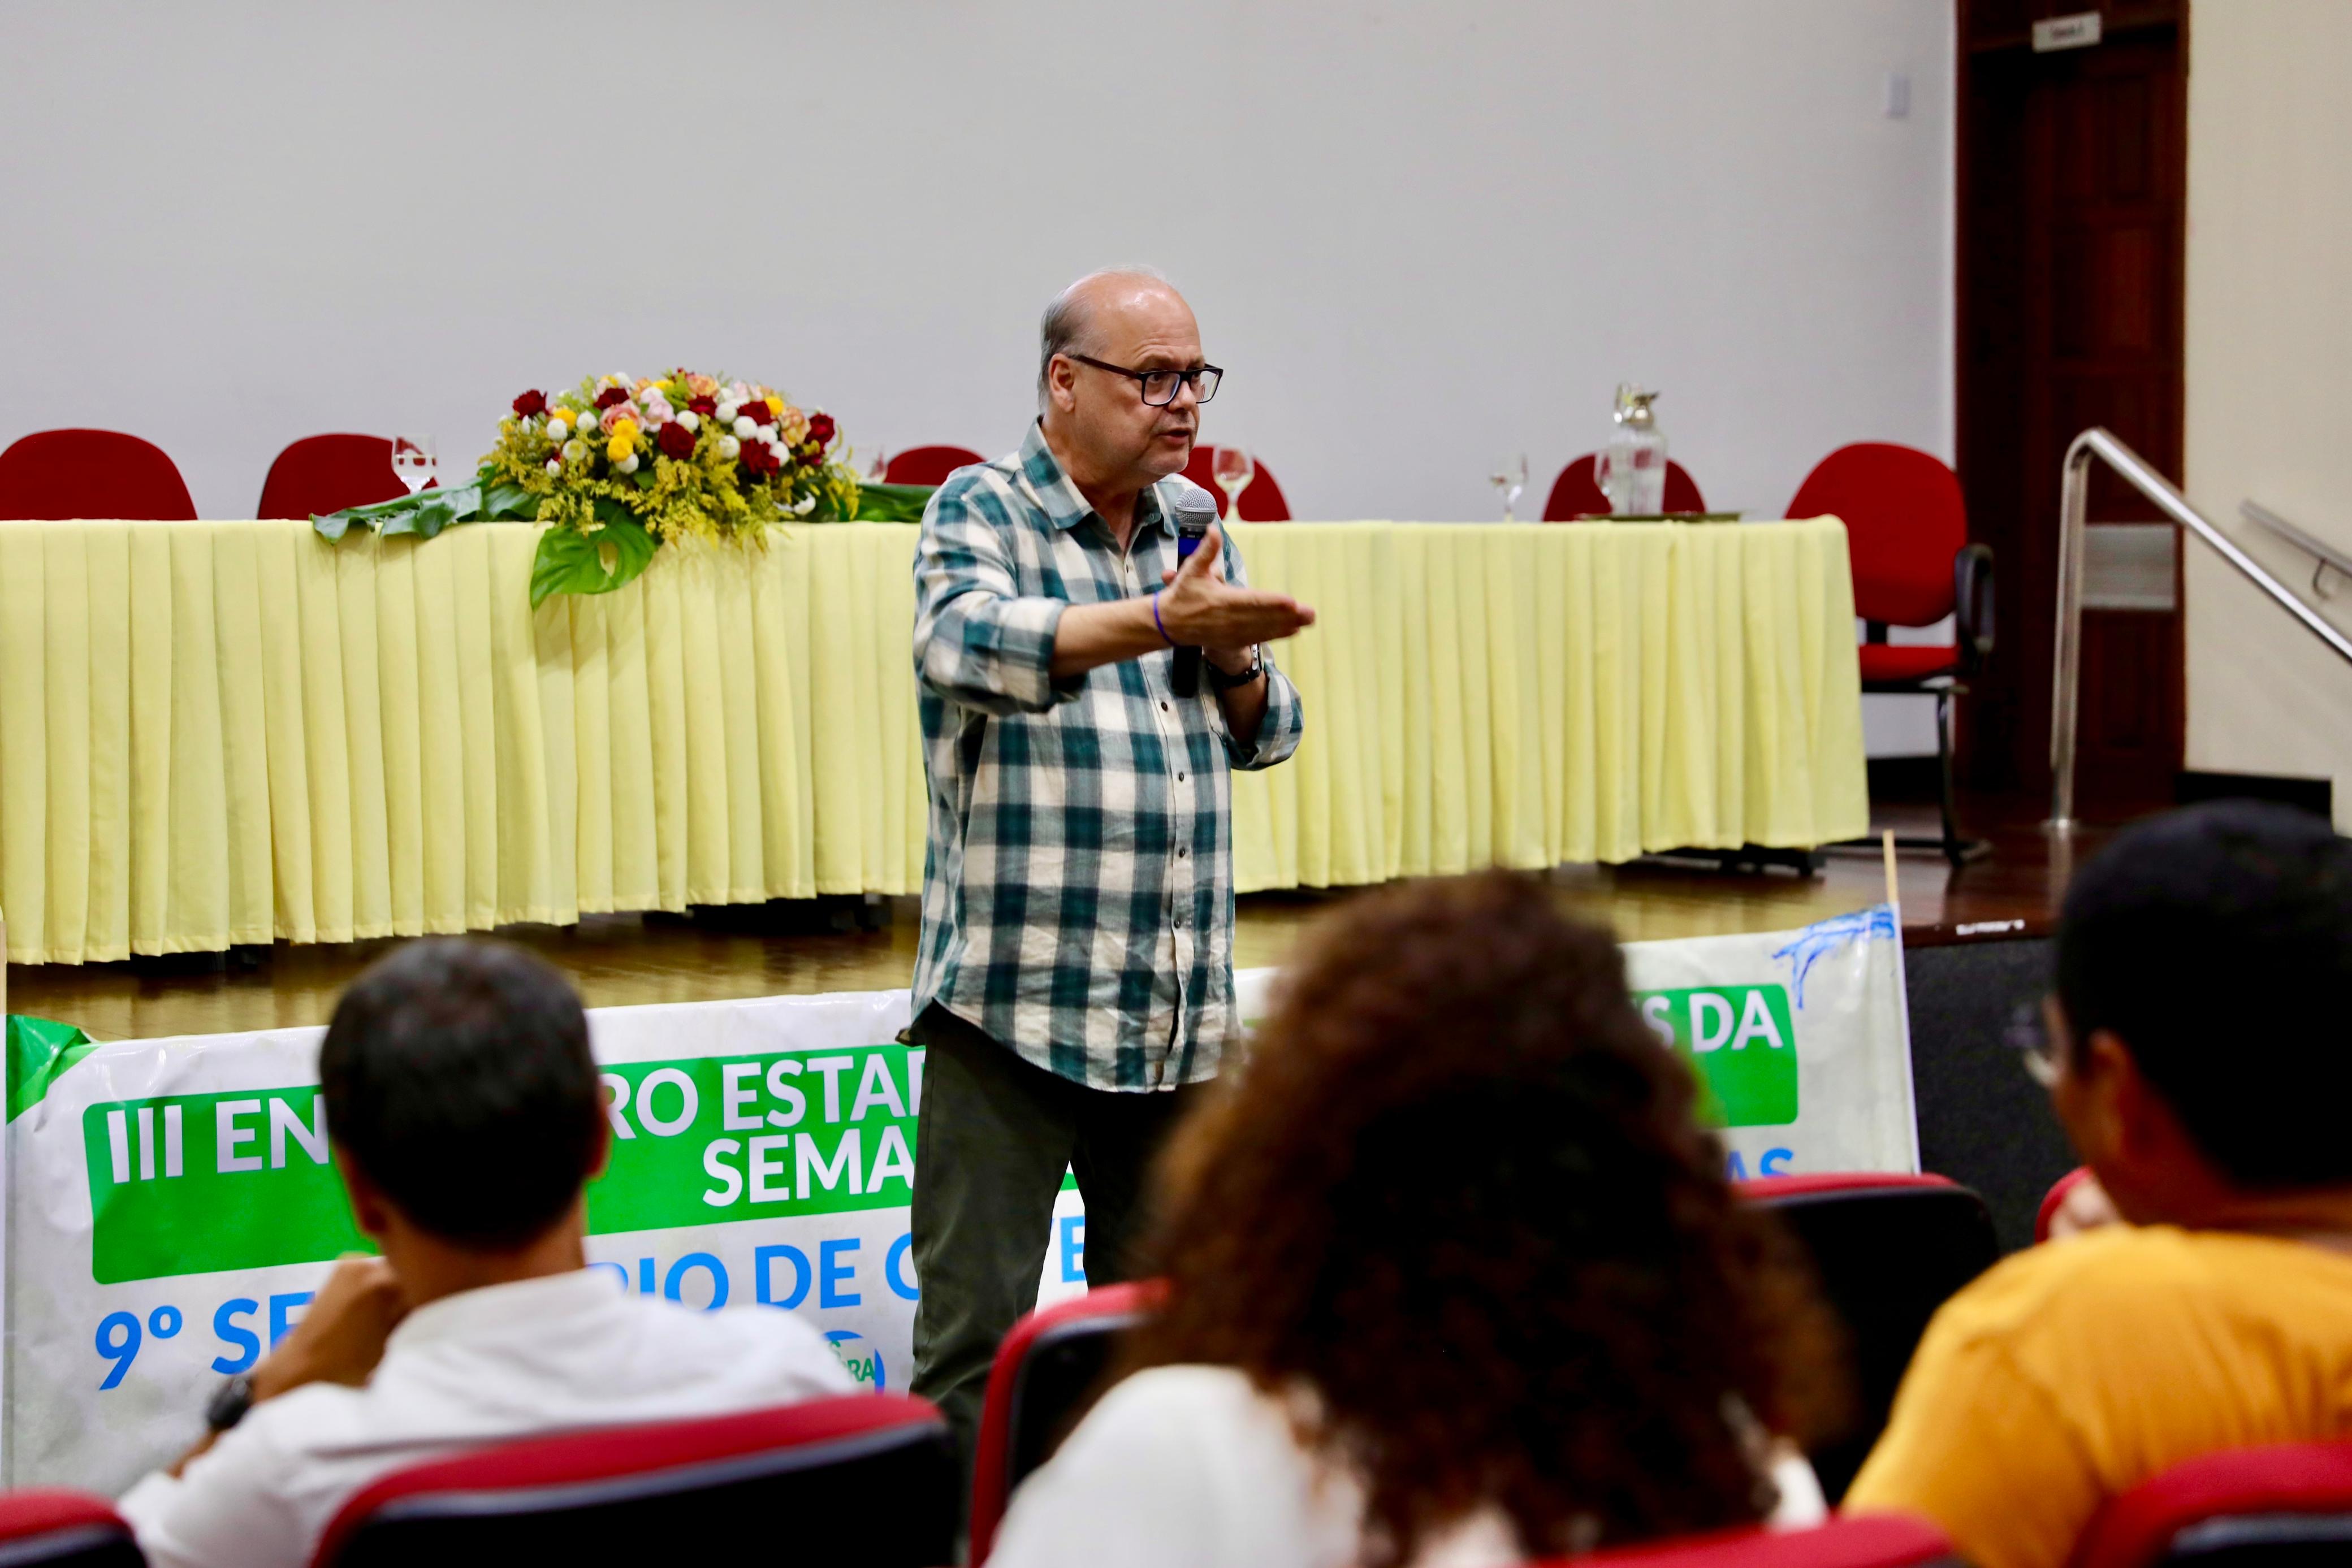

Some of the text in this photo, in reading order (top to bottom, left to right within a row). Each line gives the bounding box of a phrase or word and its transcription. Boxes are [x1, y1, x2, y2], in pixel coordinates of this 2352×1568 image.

[106, 1104, 184, 1184] III
[1689, 990, 1784, 1053] DA
[755, 1238, 861, 1312] DE
